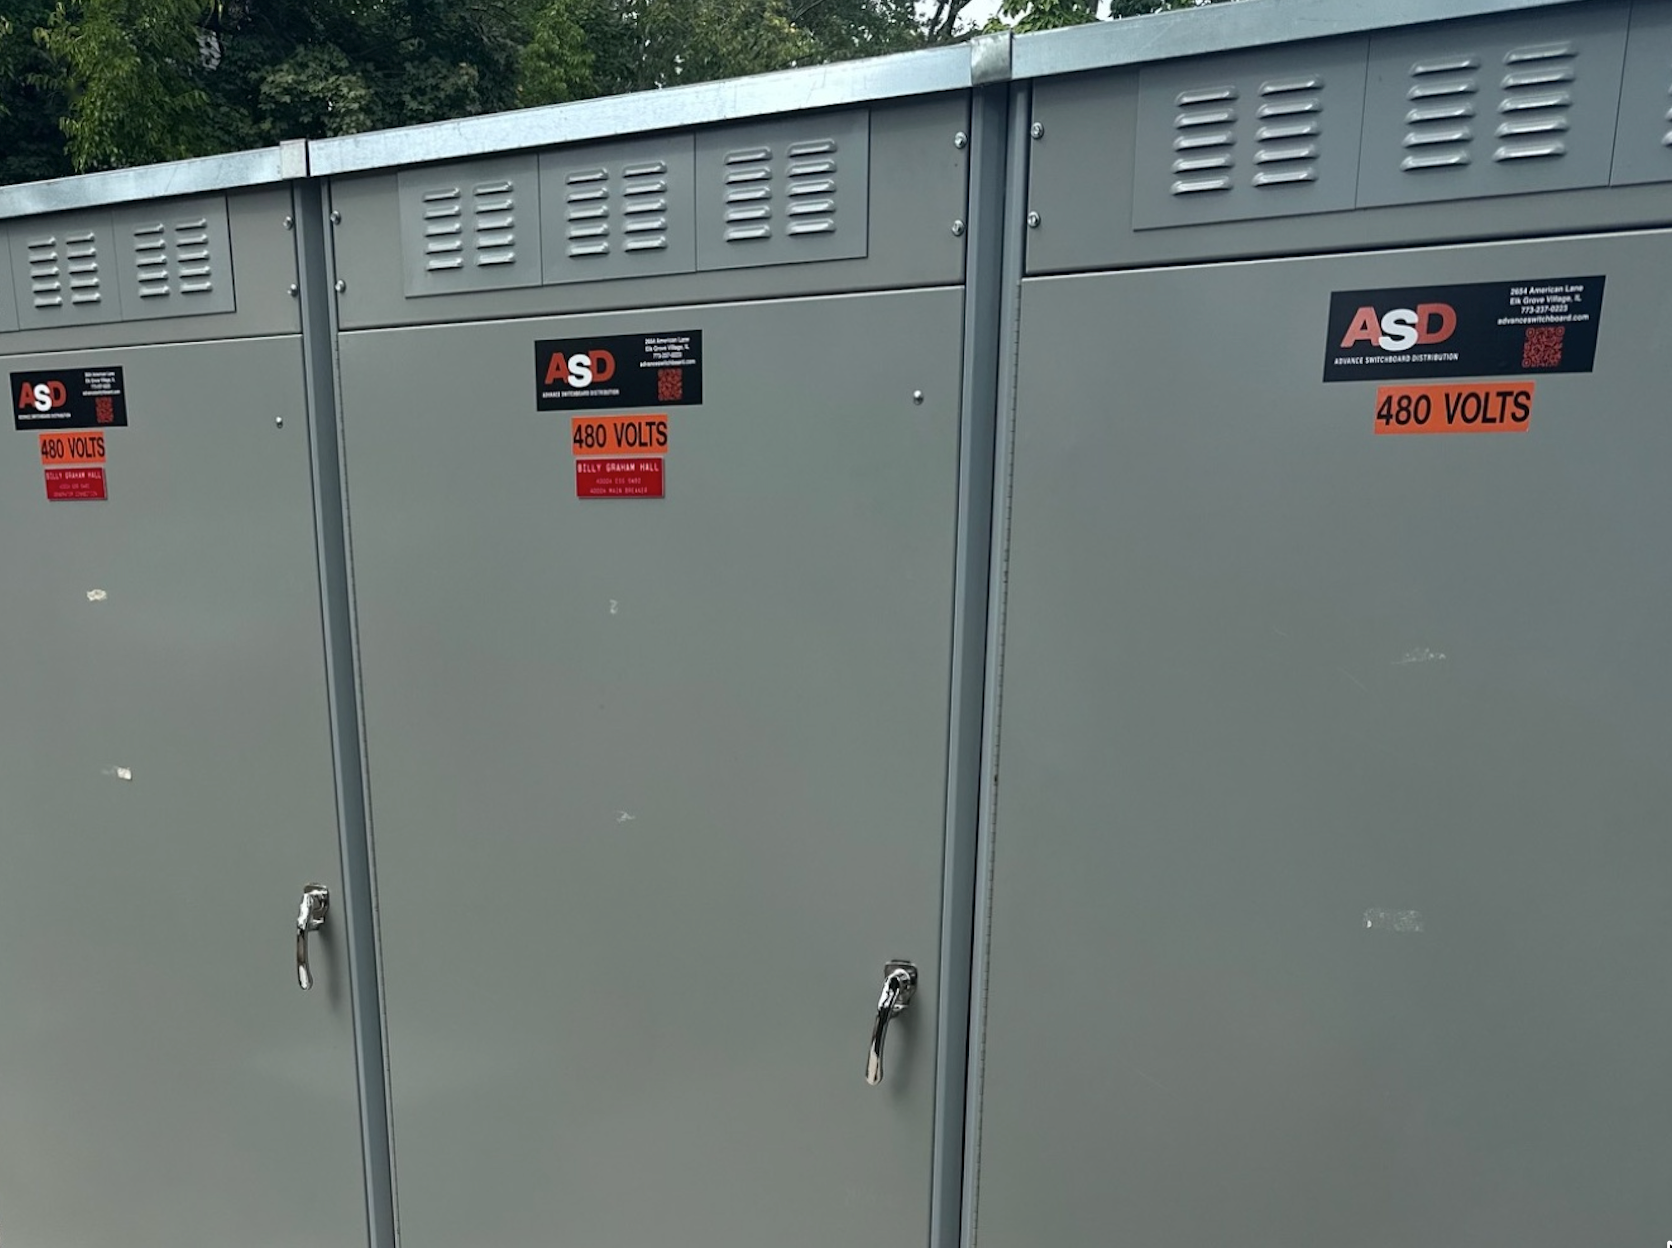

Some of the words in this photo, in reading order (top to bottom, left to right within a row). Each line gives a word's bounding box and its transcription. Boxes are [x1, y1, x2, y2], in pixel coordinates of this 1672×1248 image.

[1510, 286, 1528, 296] 2654
[1528, 285, 1563, 295] American
[1564, 284, 1584, 293] Lane
[1509, 297, 1522, 306] Elk
[1522, 296, 1545, 305] Grove
[1520, 304, 1568, 314] 773-237-0223
[1340, 302, 1457, 352] ASD
[1497, 313, 1590, 326] advanceswitchboard.com
[1333, 356, 1364, 365] ADVANCE
[1365, 354, 1411, 364] SWITCHBOARD
[1411, 352, 1460, 362] DISTRIBUTION
[544, 349, 616, 388] ASD
[18, 380, 67, 412] ASD
[1376, 394, 1431, 425] 480
[1444, 390, 1531, 424] VOLTS
[573, 423, 606, 449] 480
[613, 421, 668, 448] VOLTS
[41, 438, 65, 459] 480
[67, 436, 105, 459] VOLTS
[577, 462, 602, 473] BILLY
[605, 462, 635, 473] GRAHAM
[640, 461, 660, 472] HALL
